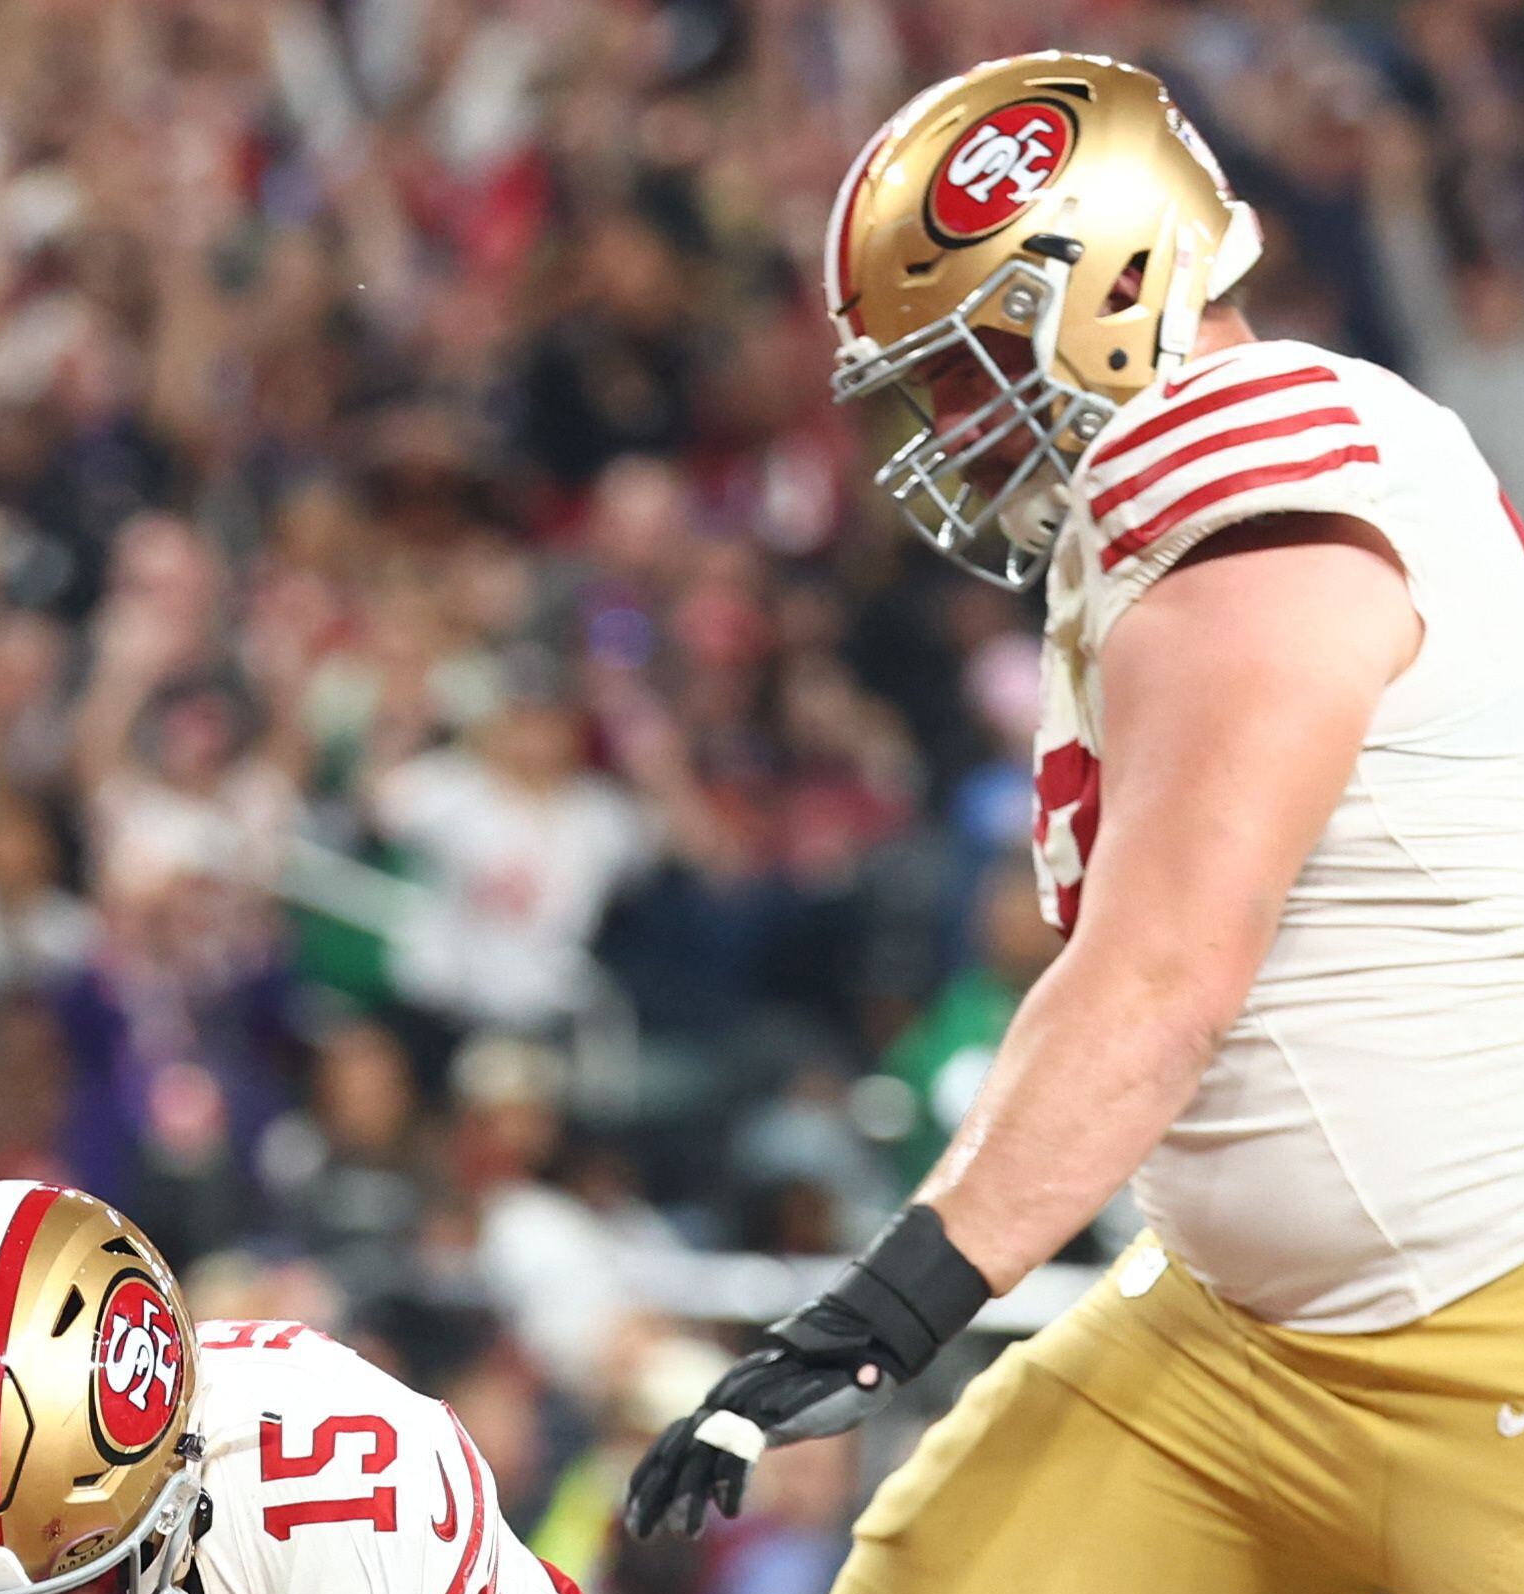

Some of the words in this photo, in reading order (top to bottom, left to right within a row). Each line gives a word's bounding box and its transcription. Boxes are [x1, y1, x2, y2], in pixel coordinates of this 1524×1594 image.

[947, 118, 1054, 204] SF
[105, 1299, 176, 1411] SF
[260, 1412, 398, 1541] 15
